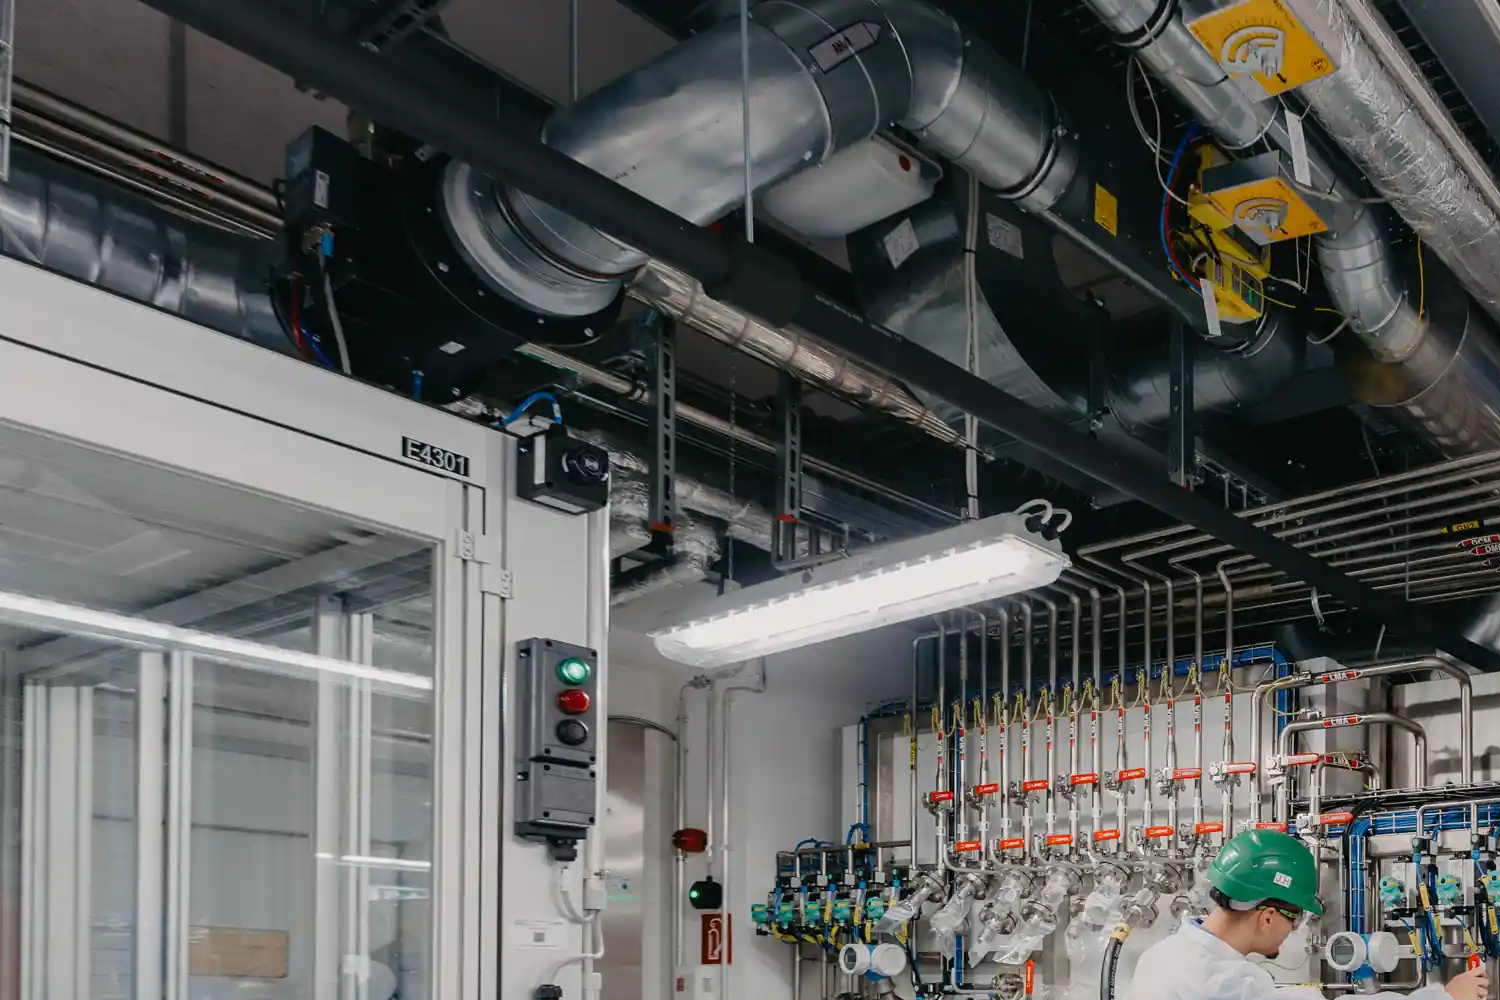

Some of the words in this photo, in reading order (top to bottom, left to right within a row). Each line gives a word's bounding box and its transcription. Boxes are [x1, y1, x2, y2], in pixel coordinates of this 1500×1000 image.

[406, 438, 465, 475] E4301
[1329, 672, 1348, 681] LMA
[1331, 717, 1349, 725] LMA
